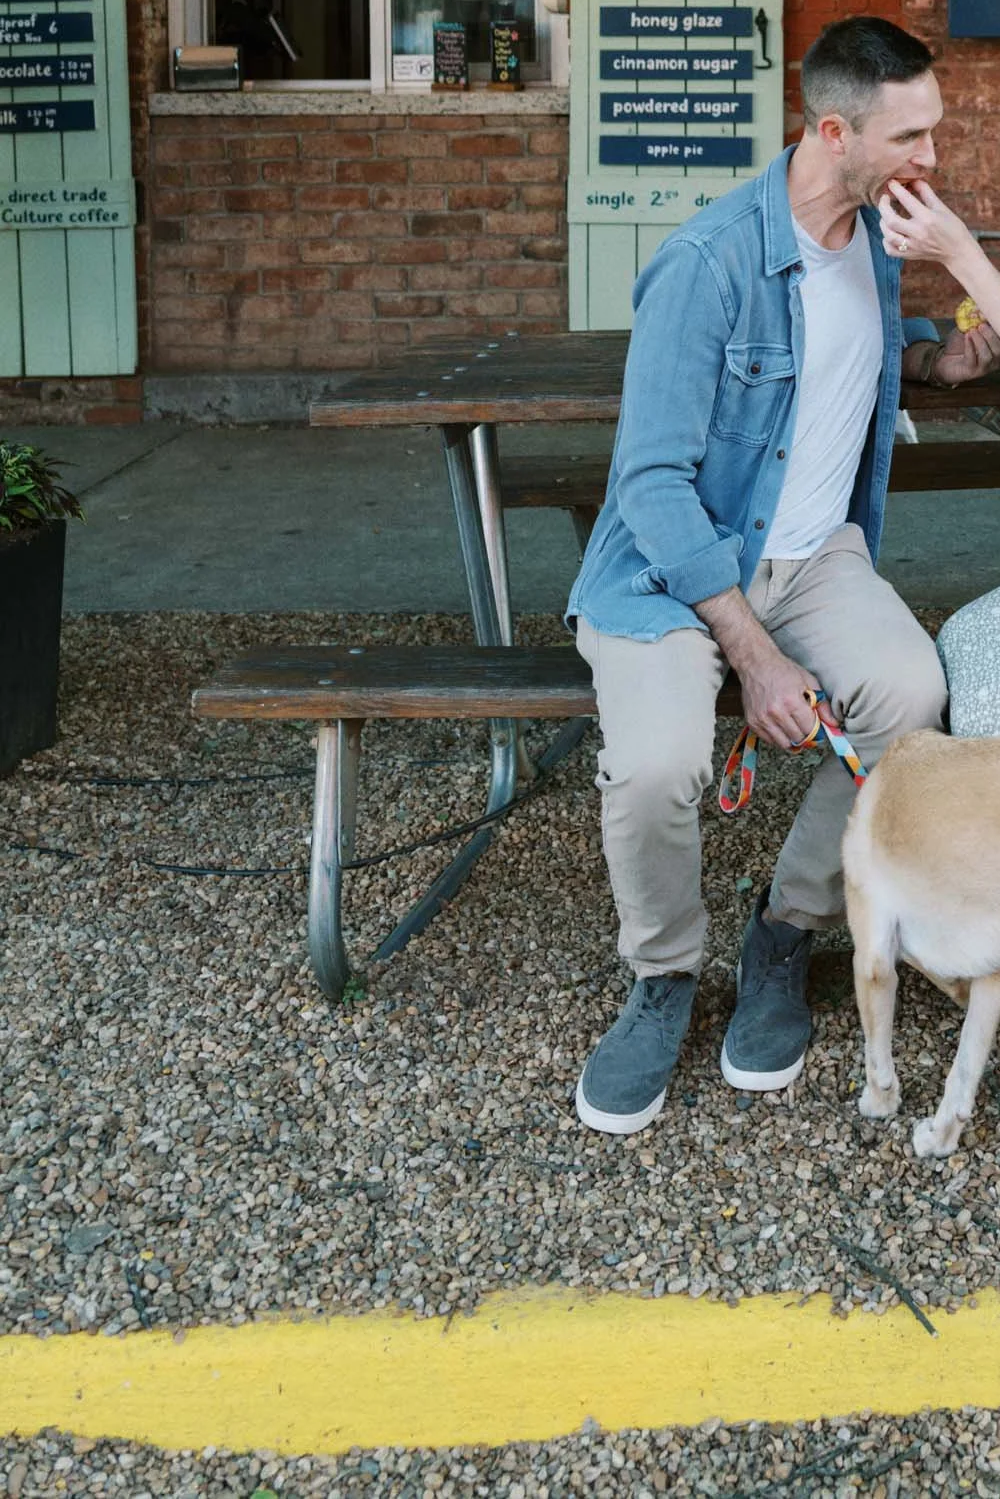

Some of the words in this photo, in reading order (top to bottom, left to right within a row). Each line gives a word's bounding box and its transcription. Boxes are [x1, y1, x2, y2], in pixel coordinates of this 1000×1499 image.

[48, 20, 58, 35] 6
[630, 12, 678, 31] honey
[682, 13, 723, 32] glaze
[613, 56, 688, 71] cinnamon
[692, 58, 738, 74] sugar
[613, 99, 689, 117] powdered
[693, 101, 740, 118] sugar
[647, 144, 680, 158] apple
[684, 145, 704, 159] pie
[8, 190, 57, 203] direct
[62, 187, 107, 202] trade
[586, 191, 635, 210] single
[1, 208, 63, 223] Culture
[69, 207, 119, 222] coffee
